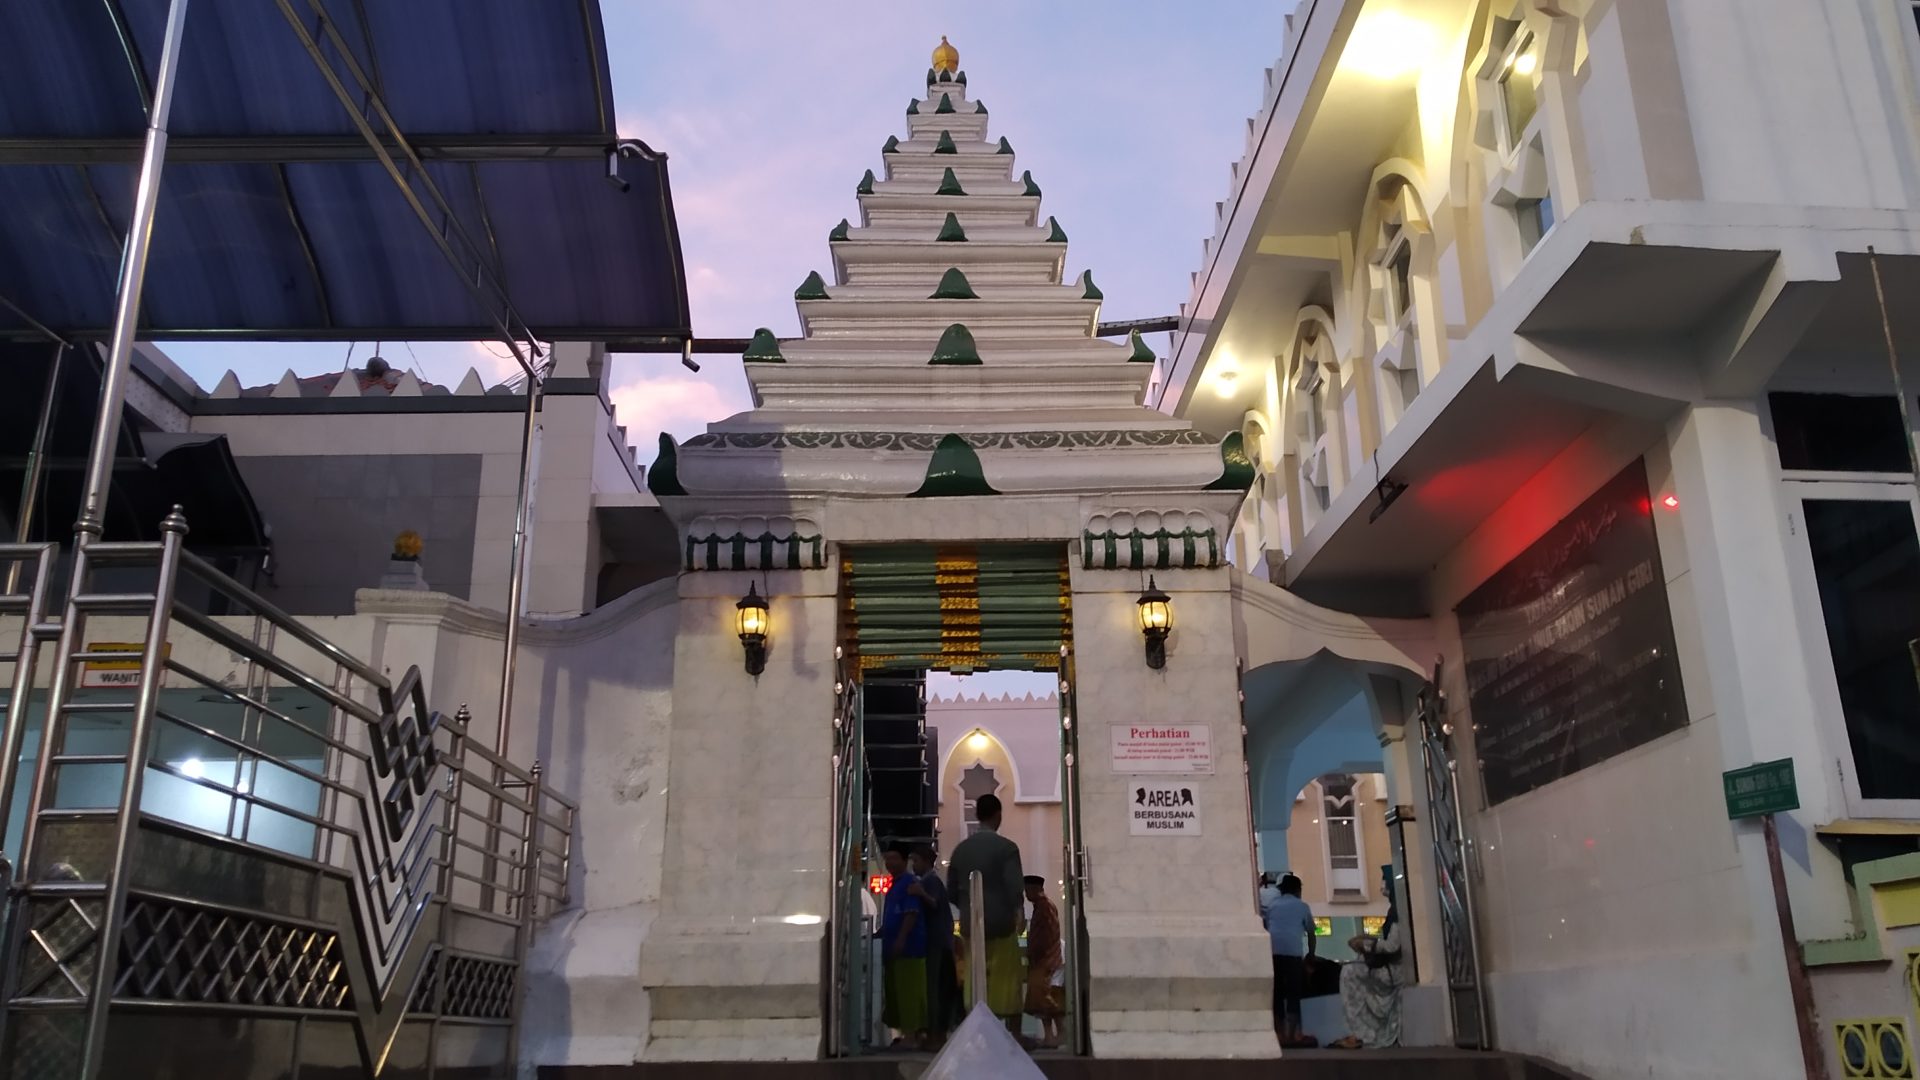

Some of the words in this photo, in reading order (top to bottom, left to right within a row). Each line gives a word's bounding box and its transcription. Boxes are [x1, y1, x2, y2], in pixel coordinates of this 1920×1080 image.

[1585, 575, 1627, 621] SUNAN
[1625, 557, 1654, 595] GIRI
[101, 673, 140, 683] WANIT
[1130, 727, 1190, 739] Perhatian
[1148, 790, 1181, 807] AREA
[1134, 810, 1195, 819] BERBUSANA
[1146, 821, 1184, 829] MUSLIM
